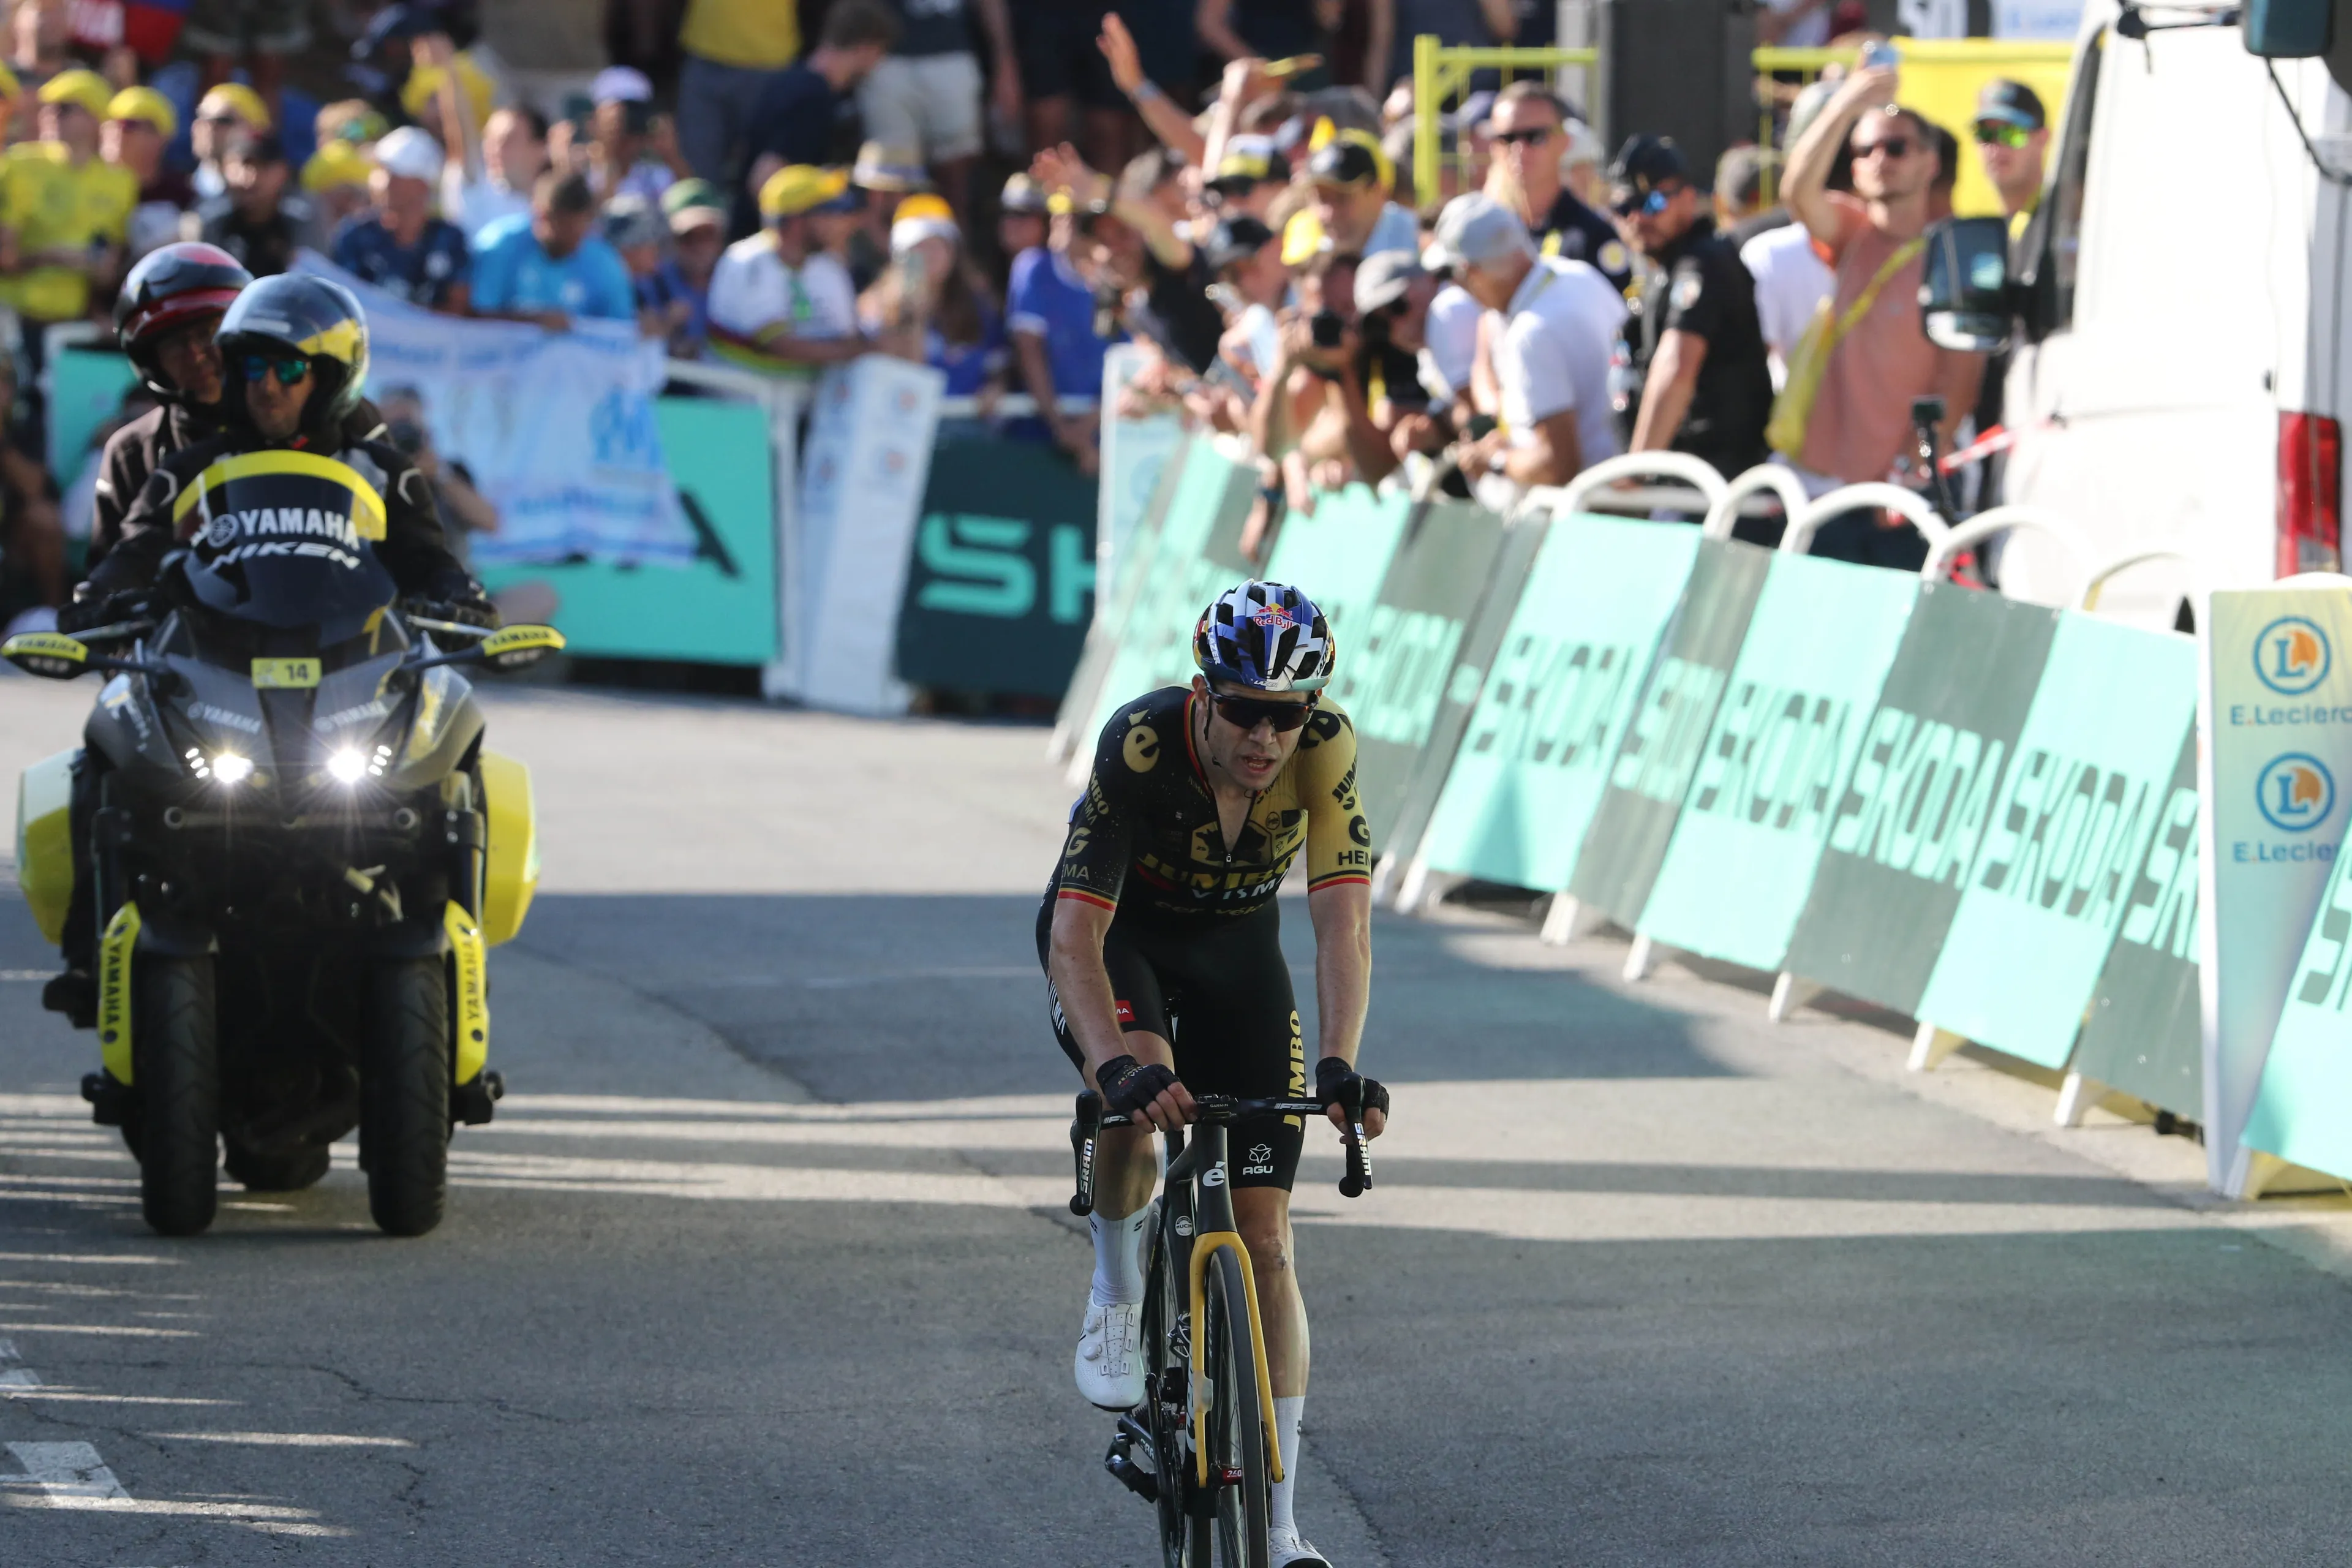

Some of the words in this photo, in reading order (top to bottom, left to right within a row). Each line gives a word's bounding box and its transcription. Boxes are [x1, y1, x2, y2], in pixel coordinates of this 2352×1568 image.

[239, 508, 360, 551] YAMAHA
[205, 541, 360, 570] NIKEN
[1254, 614, 1273, 627] Red
[1274, 616, 1292, 629] Bull
[1207, 631, 1221, 665] LAZER
[285, 664, 309, 680] 14
[203, 704, 261, 734] YAMAHA
[1089, 763, 1109, 815] MBO
[1332, 757, 1357, 803] JUM
[1830, 706, 2004, 889] SKODA
[1066, 827, 1091, 857] G
[1349, 815, 1371, 847] G
[1980, 748, 2150, 929] SKODA
[1338, 850, 1371, 865] HEM
[2234, 840, 2339, 864] E.Lecle
[105, 942, 121, 1025] YAMAHA
[1354, 1122, 1372, 1176] SRAM
[1080, 1137, 1093, 1194] SRAM
[1202, 1161, 1226, 1187] é
[1243, 1166, 1273, 1175] AGU
